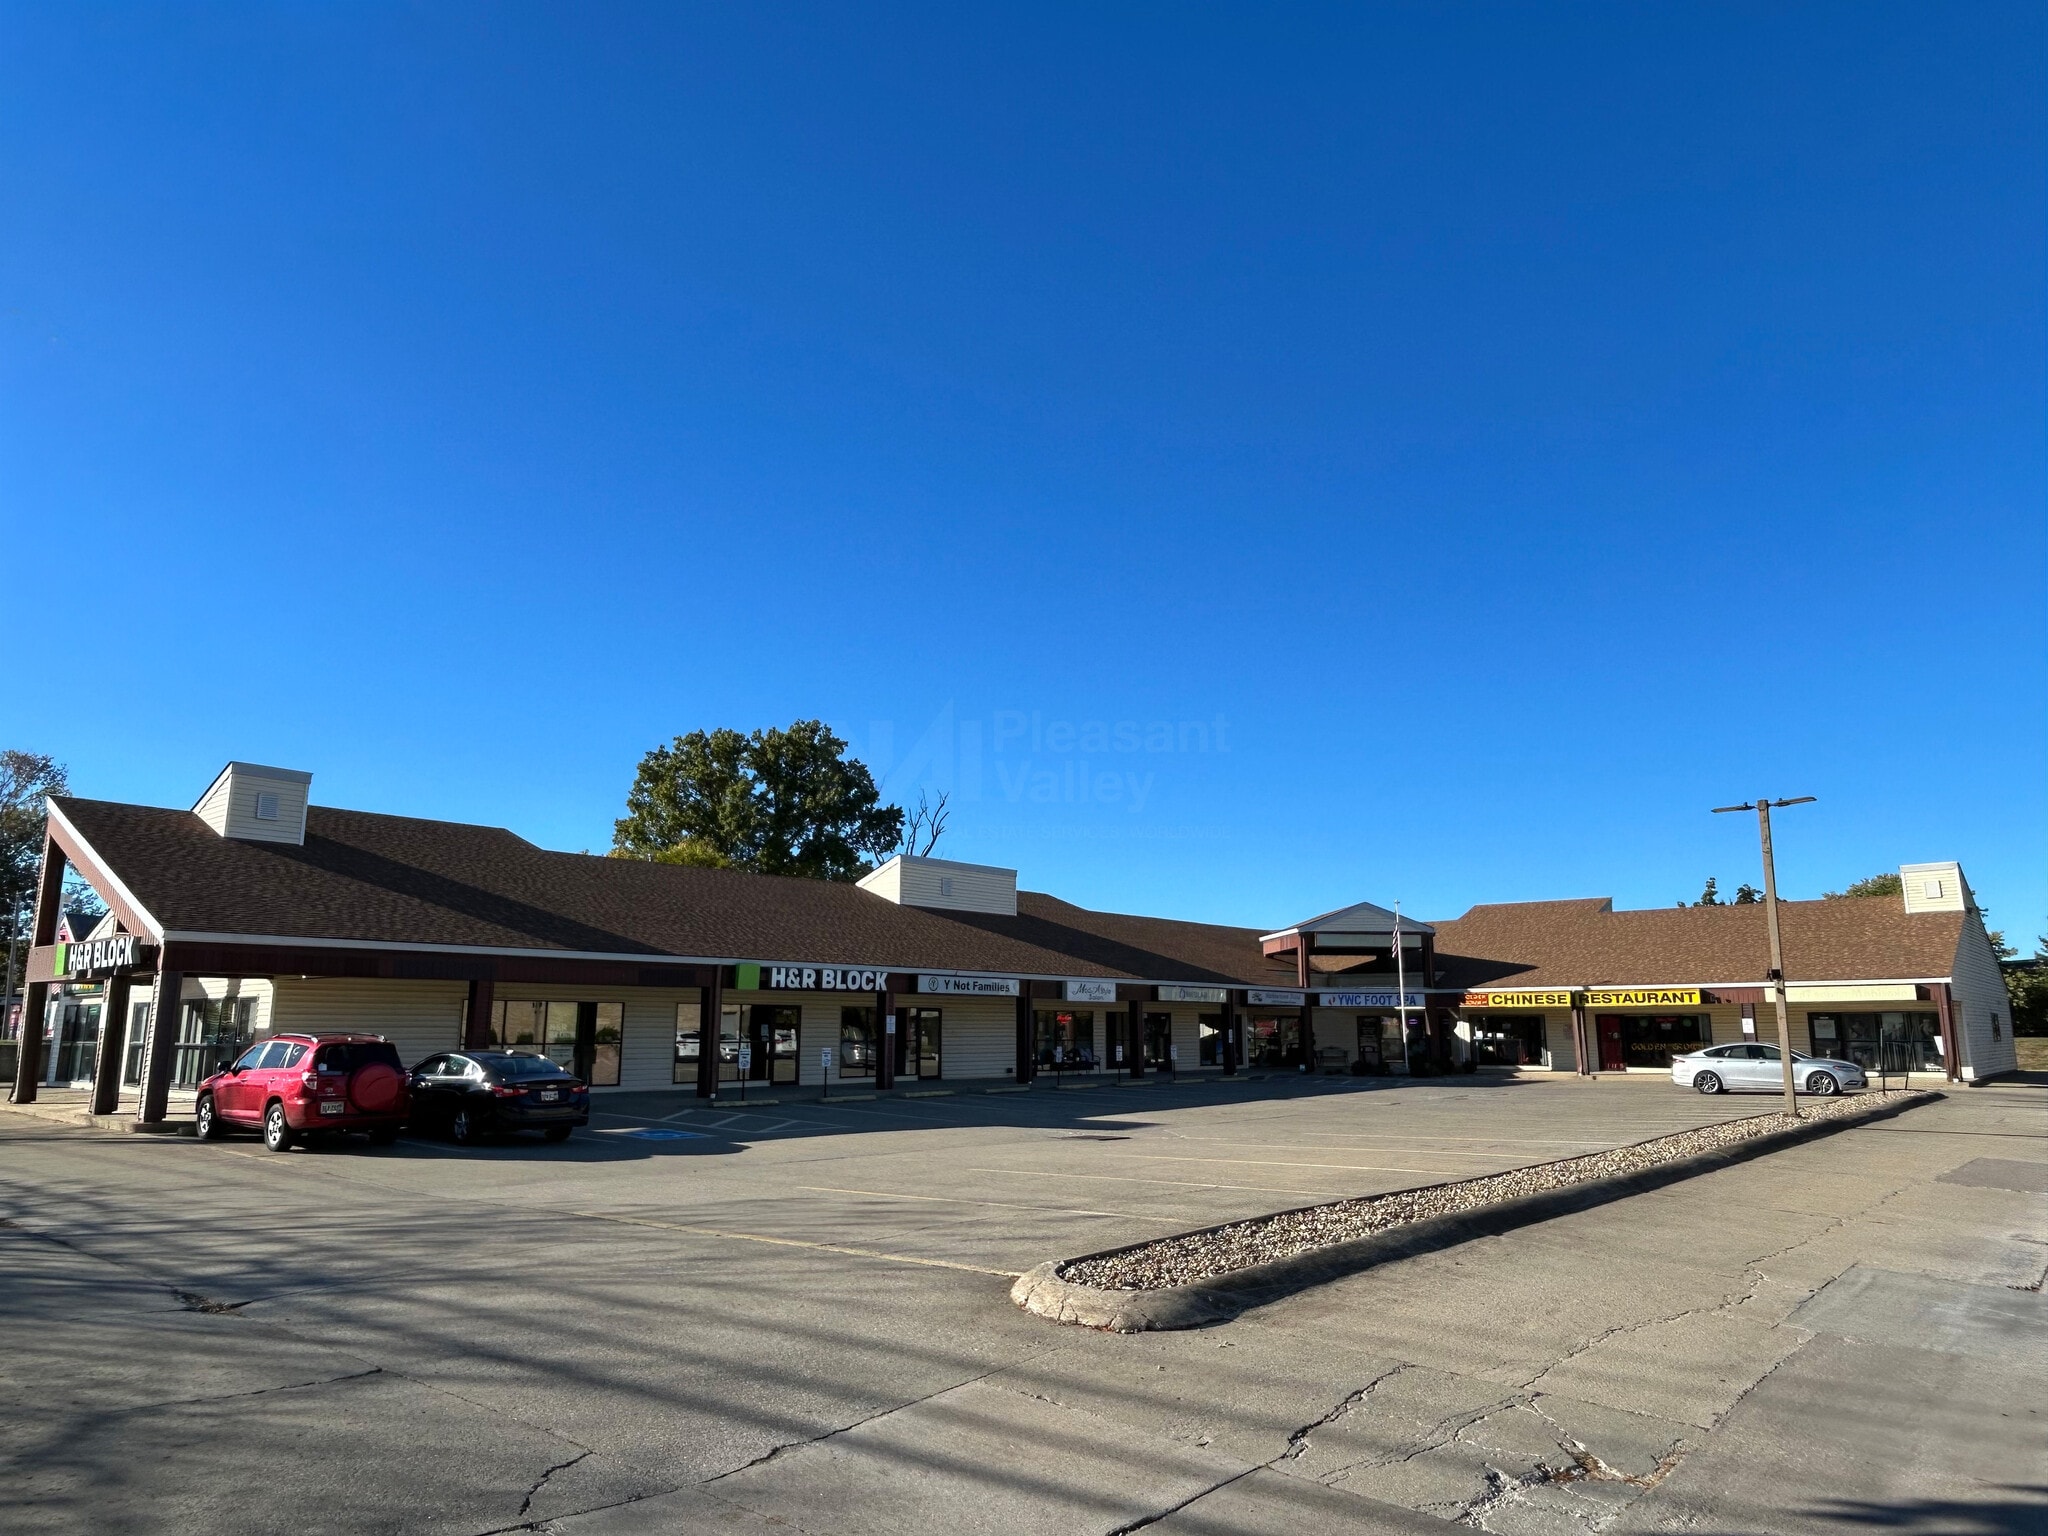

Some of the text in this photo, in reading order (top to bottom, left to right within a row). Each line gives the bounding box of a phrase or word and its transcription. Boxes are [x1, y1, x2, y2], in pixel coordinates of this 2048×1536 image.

[68, 936, 135, 972] H&R BLOCK
[770, 966, 888, 991] H&R BLOCK
[944, 980, 1010, 993] Y Not Families
[1337, 994, 1362, 1006] YWC
[1364, 994, 1392, 1006] FOOT
[1492, 993, 1568, 1006] CHINESE
[1578, 991, 1697, 1006] RESTAURANT
[1631, 1042, 1666, 1051] GOLDEN
